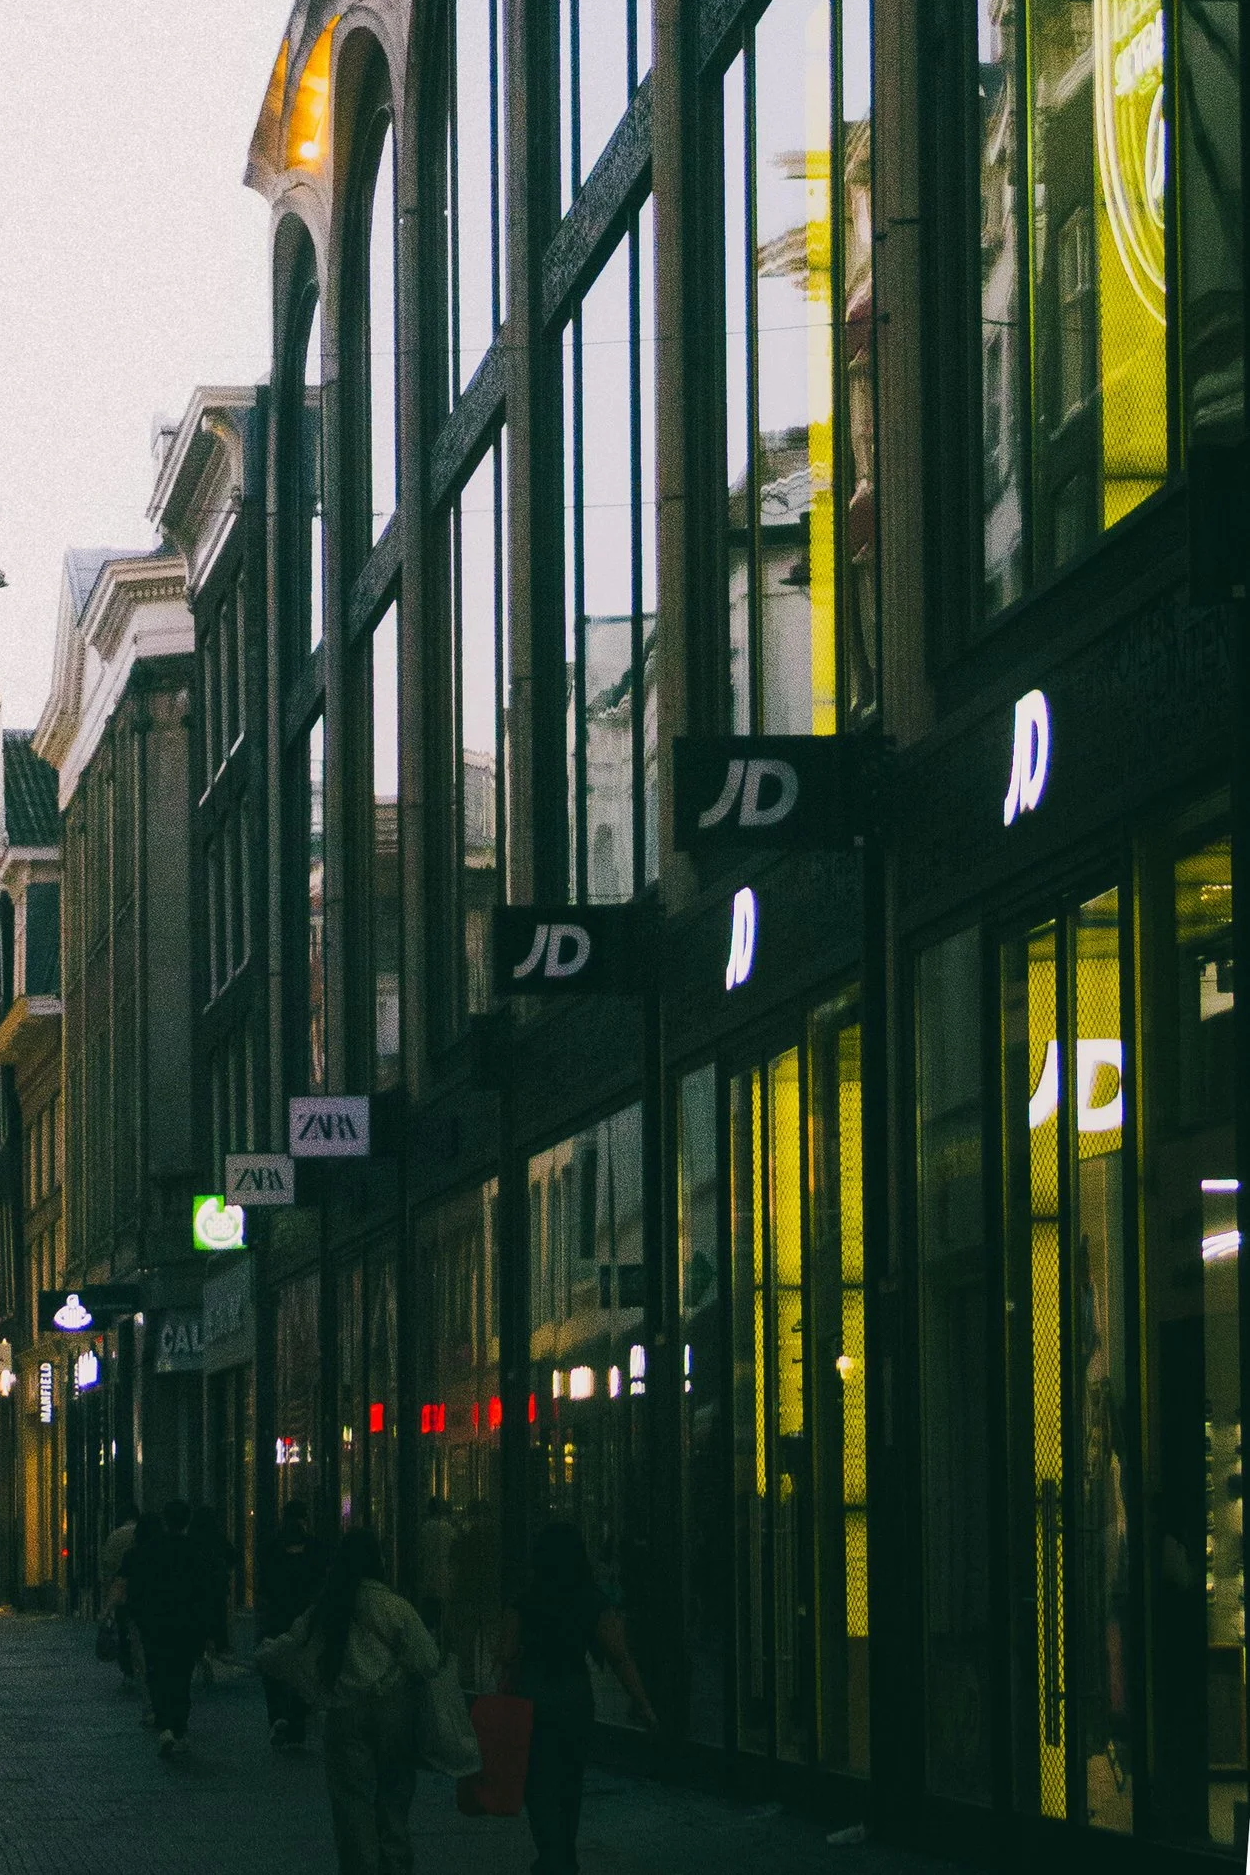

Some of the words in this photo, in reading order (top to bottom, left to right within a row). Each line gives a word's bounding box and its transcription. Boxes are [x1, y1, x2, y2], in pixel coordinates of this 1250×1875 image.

[1003, 688, 1050, 828] JD
[698, 759, 800, 829] JD
[513, 924, 591, 979] JD
[725, 886, 757, 992] JD
[1029, 1038, 1123, 1133] JD
[298, 1113, 358, 1141] ZARA
[233, 1168, 285, 1192] ZARA
[39, 1362, 52, 1423] MANFIELD
